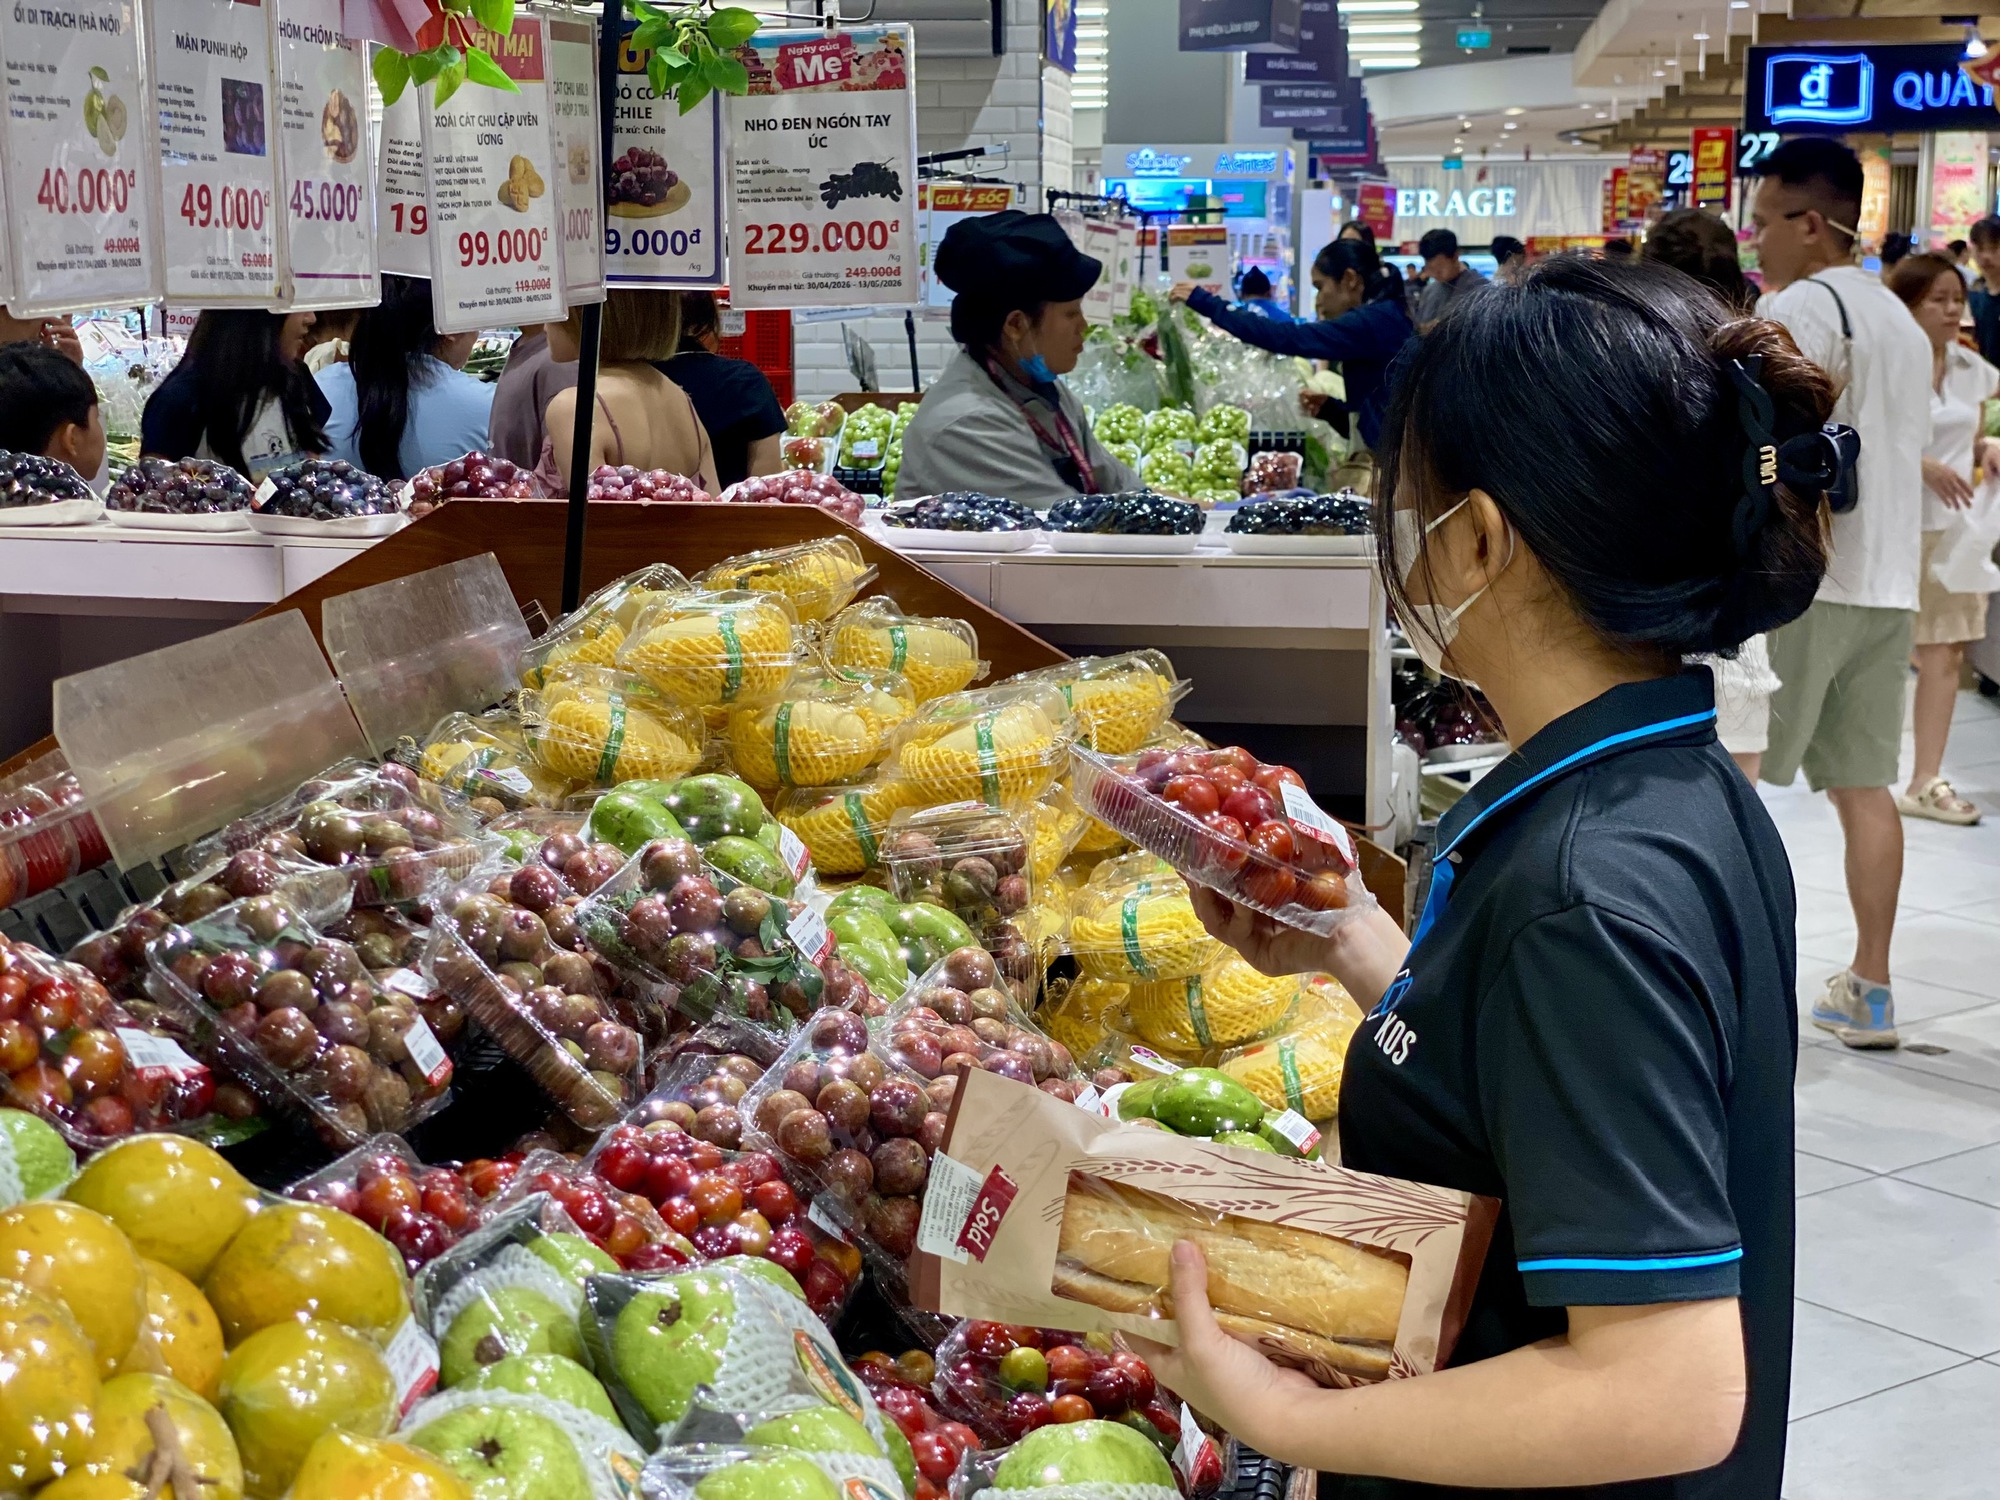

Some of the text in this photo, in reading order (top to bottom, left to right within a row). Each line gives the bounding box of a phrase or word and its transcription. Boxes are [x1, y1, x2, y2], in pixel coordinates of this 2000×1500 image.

[28, 9, 38, 24] DI
[40, 10, 76, 30] TRẠCH
[303, 25, 333, 47] CHÔM
[176, 32, 248, 63] MẬN PUNHI HỘP
[787, 41, 840, 56] Ngày của
[794, 54, 842, 84] Mẹ
[434, 111, 538, 130] XOÀI CÁT CHU CẶP UYÊN
[643, 125, 666, 134] Chile
[745, 112, 891, 132] NHO ĐEN NGÓN TAY
[389, 138, 403, 147] Xuất
[808, 133, 828, 148] ÚC
[1739, 132, 1780, 168] 27
[388, 148, 415, 158] Nho đen
[1214, 153, 1277, 174] Acnes
[385, 177, 398, 186] oxy
[935, 192, 959, 205] GIÁ
[976, 189, 1006, 203] SỐC
[1397, 187, 1517, 218] ERAGE
[390, 203, 428, 235] 19
[458, 227, 548, 267] 99.000đ
[745, 220, 900, 255] 229.000đ
[688, 263, 702, 272] /kg
[888, 254, 901, 262] /Kg
[802, 271, 814, 279] Giá
[845, 266, 901, 279] 249.000đ
[515, 277, 551, 293] 119.000đ
[748, 281, 776, 292] Khuyến
[777, 282, 792, 291] mại
[807, 280, 850, 290] 30/04/2026
[858, 279, 902, 289] 13/05/2026
[1374, 1012, 1417, 1065] KOS
[967, 1197, 1000, 1251] Sold
